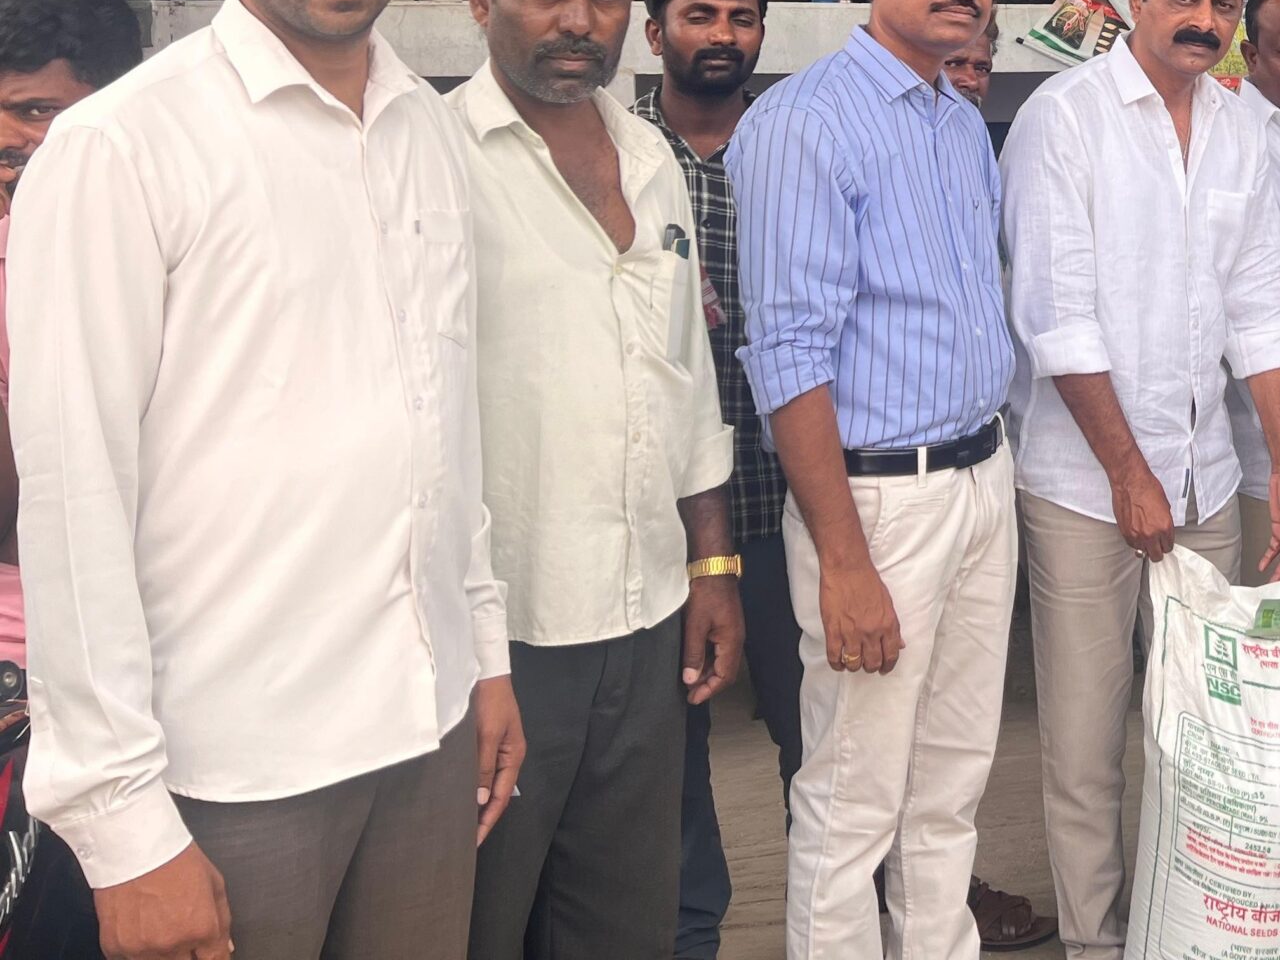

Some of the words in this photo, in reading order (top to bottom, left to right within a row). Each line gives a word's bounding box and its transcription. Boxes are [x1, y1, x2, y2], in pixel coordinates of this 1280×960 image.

[1207, 677, 1241, 697] NSC
[1203, 892, 1248, 921] राष्ट्रीय
[1206, 914, 1248, 937] NATIONAL
